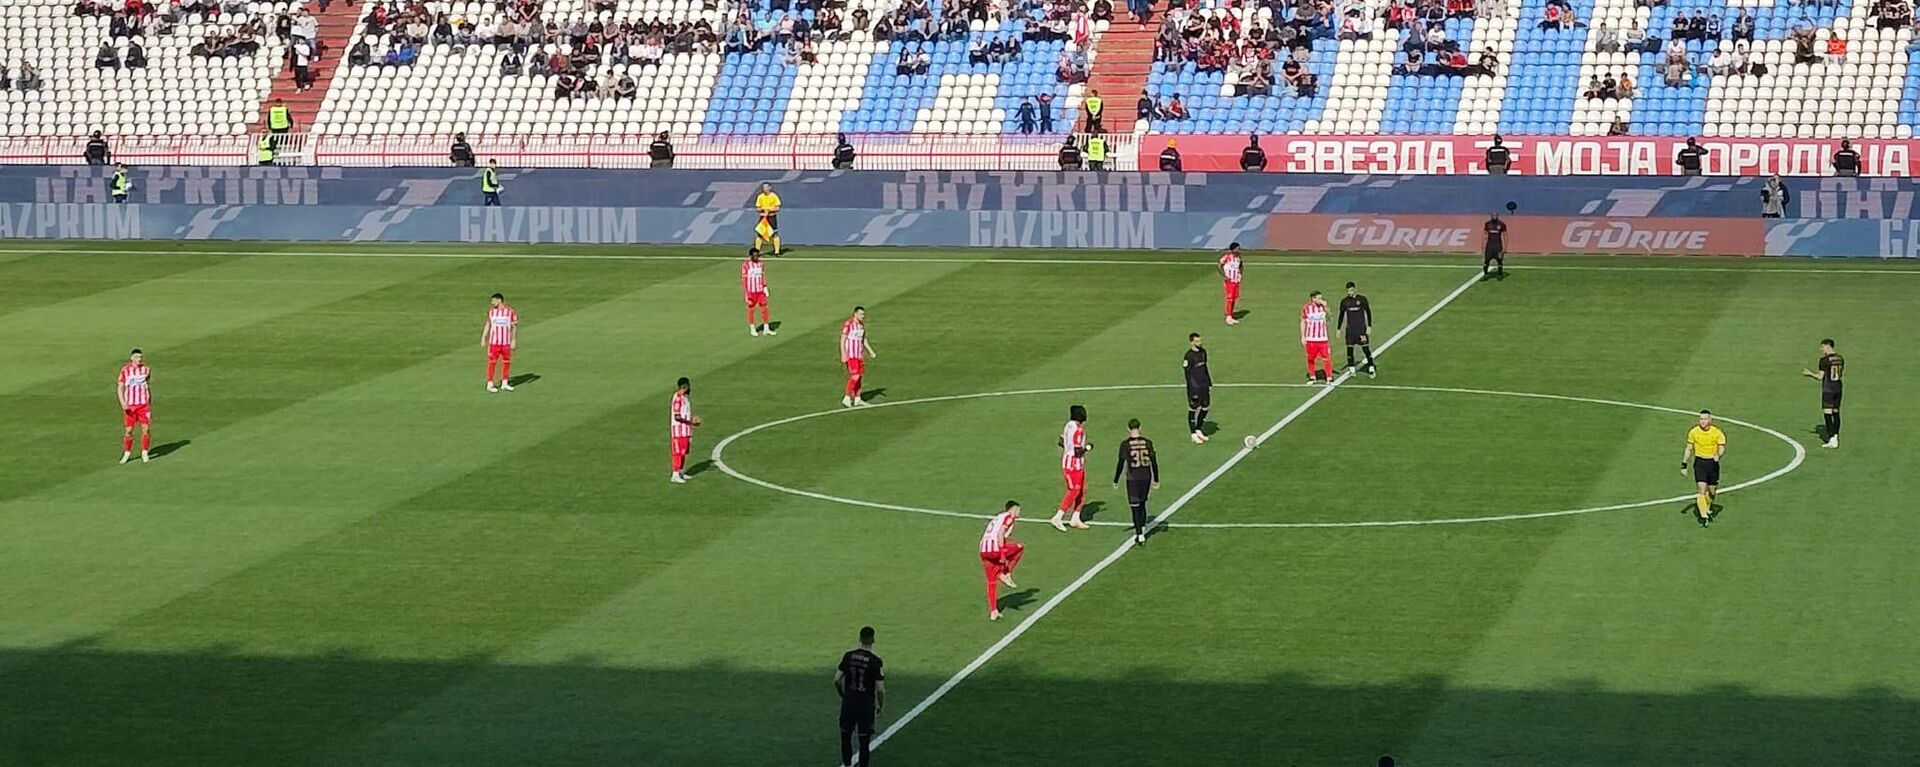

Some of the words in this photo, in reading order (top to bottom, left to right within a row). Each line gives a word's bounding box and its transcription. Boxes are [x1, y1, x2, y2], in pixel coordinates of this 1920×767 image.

[1287, 140, 1456, 175] ЗВЕЗДА
[1536, 141, 1657, 176] МОЈА
[460, 206, 637, 244] GAZPROM
[969, 210, 1154, 248] GAZPROM
[1130, 449, 1150, 468] 36
